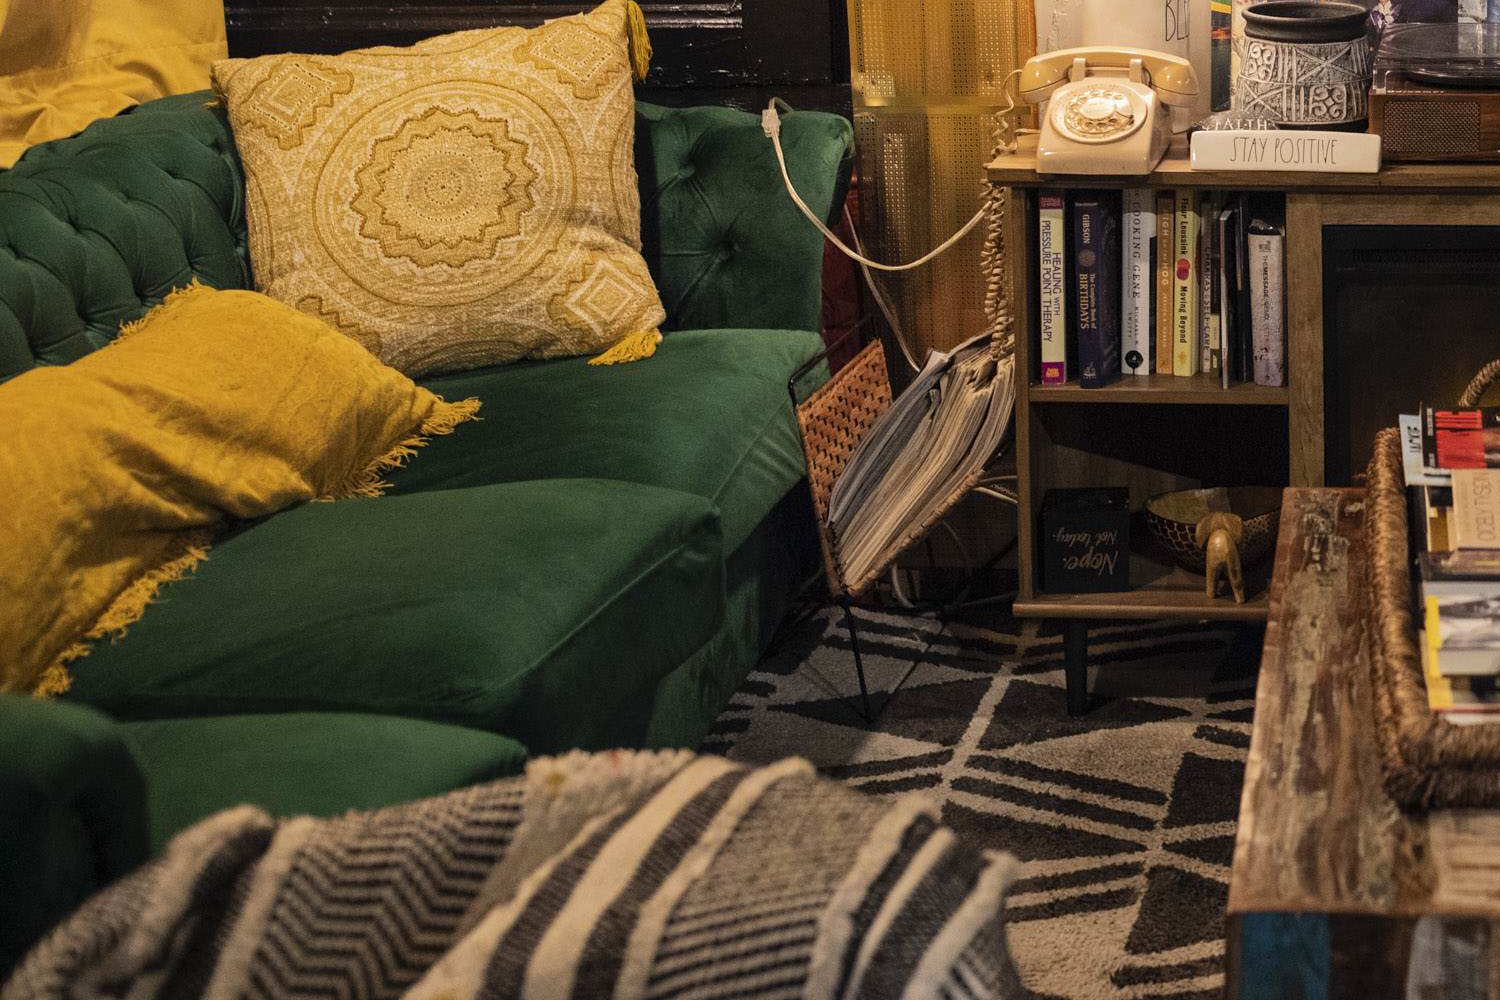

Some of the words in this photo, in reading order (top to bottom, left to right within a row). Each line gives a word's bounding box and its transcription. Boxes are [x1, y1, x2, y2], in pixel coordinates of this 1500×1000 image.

[1230, 136, 1268, 164] STAY
[1274, 137, 1338, 164] POSITIVE
[1042, 220, 1051, 265] PRESSURE
[1082, 214, 1091, 244] GIBSON
[1132, 201, 1141, 258] COOKING
[1042, 267, 1052, 295] POINT
[1052, 252, 1061, 294] HEALING
[1132, 264, 1141, 299] GENE
[1079, 273, 1089, 329] BIRTHDAYS
[1179, 285, 1188, 313] Moving
[1042, 299, 1053, 342] THERAPY
[1179, 315, 1188, 343] Beyond
[1095, 528, 1118, 545] Not
[1063, 550, 1118, 576] Nope.
